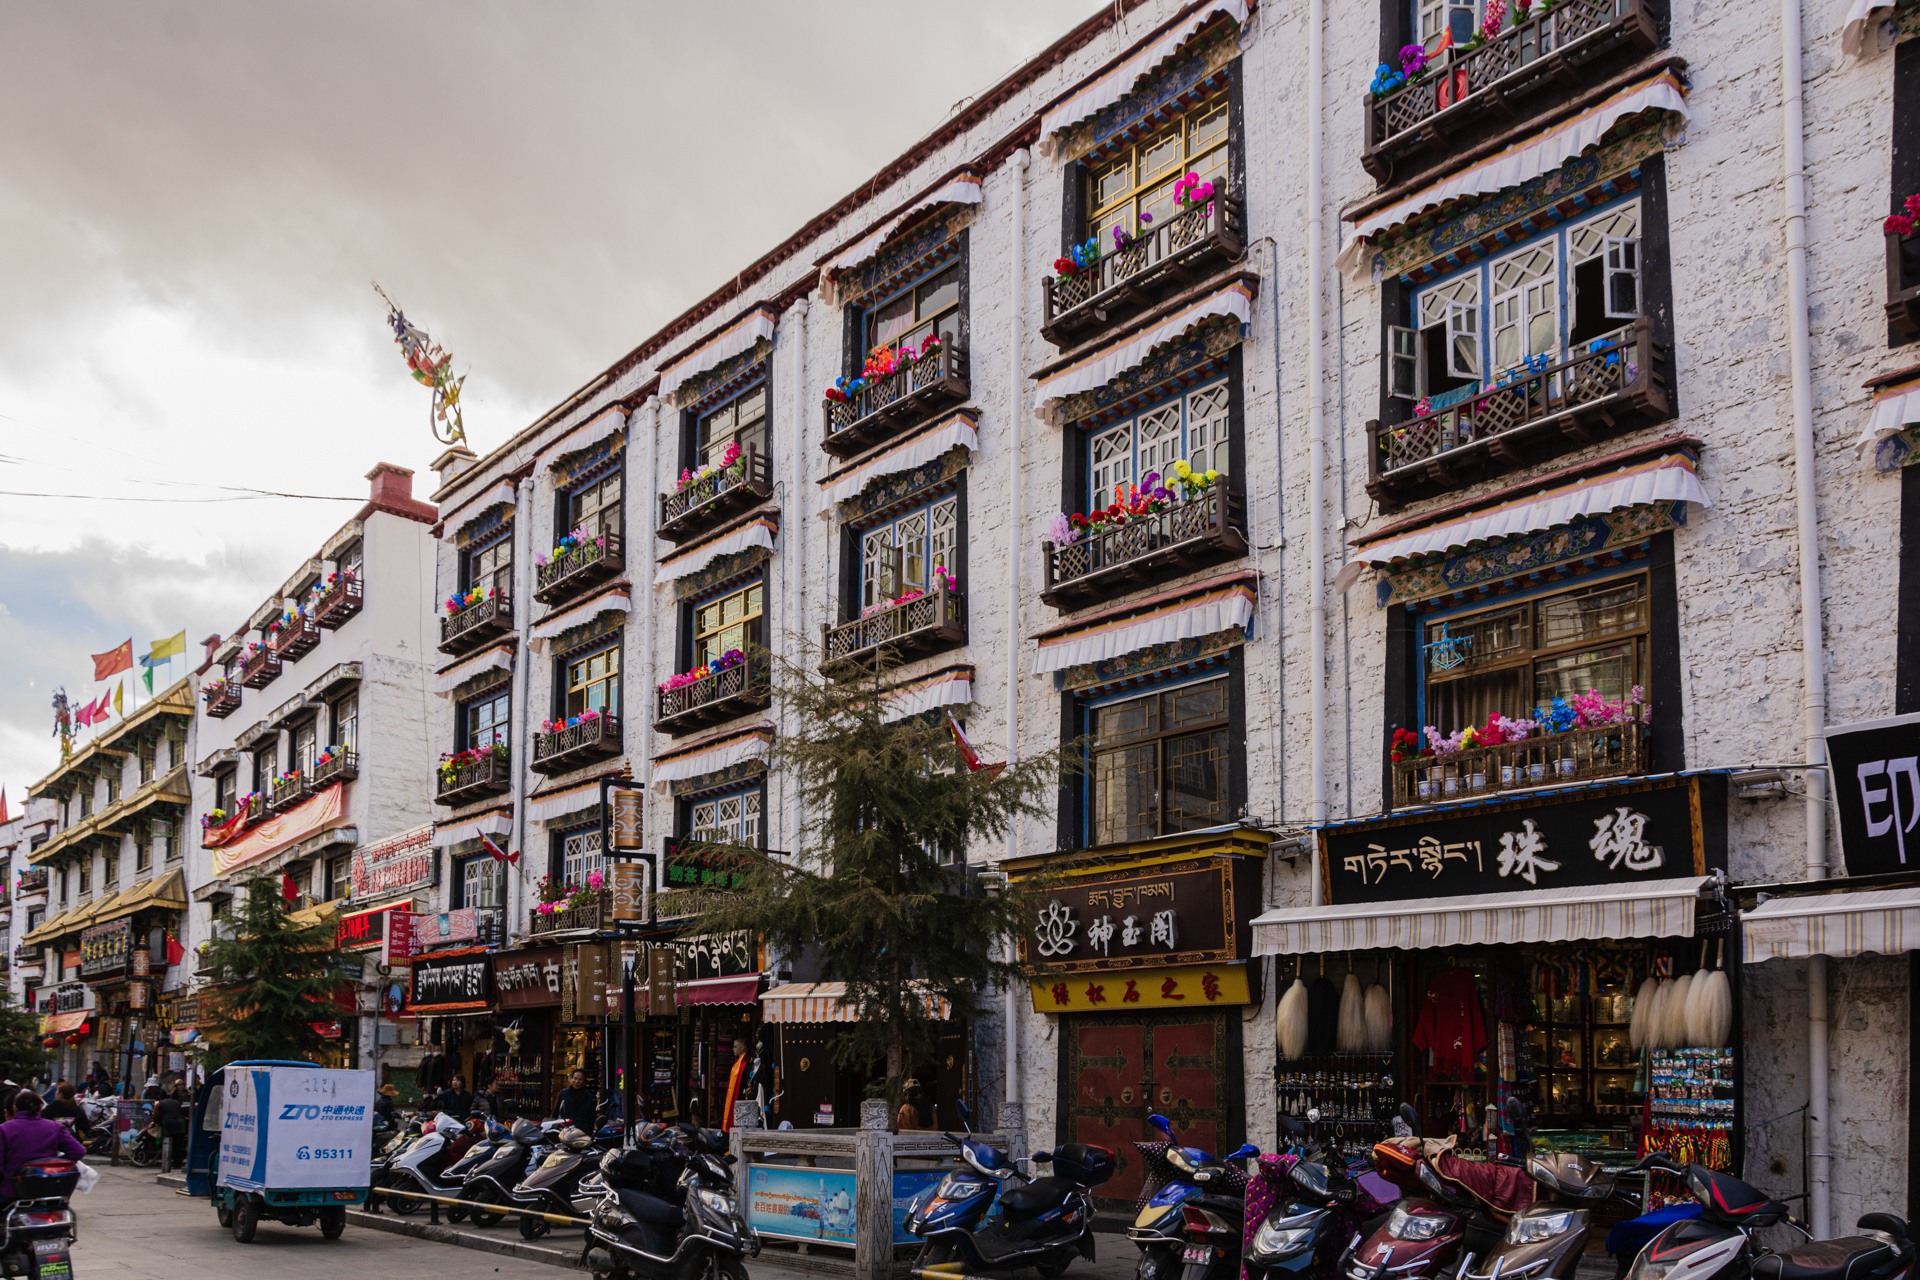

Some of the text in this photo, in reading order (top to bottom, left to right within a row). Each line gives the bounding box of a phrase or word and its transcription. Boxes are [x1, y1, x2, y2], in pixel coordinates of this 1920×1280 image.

[1857, 756, 1920, 864] 印
[670, 865, 698, 884] 奶茶
[278, 1104, 365, 1120] ZTO 中通快递
[314, 1149, 353, 1160] 95311
